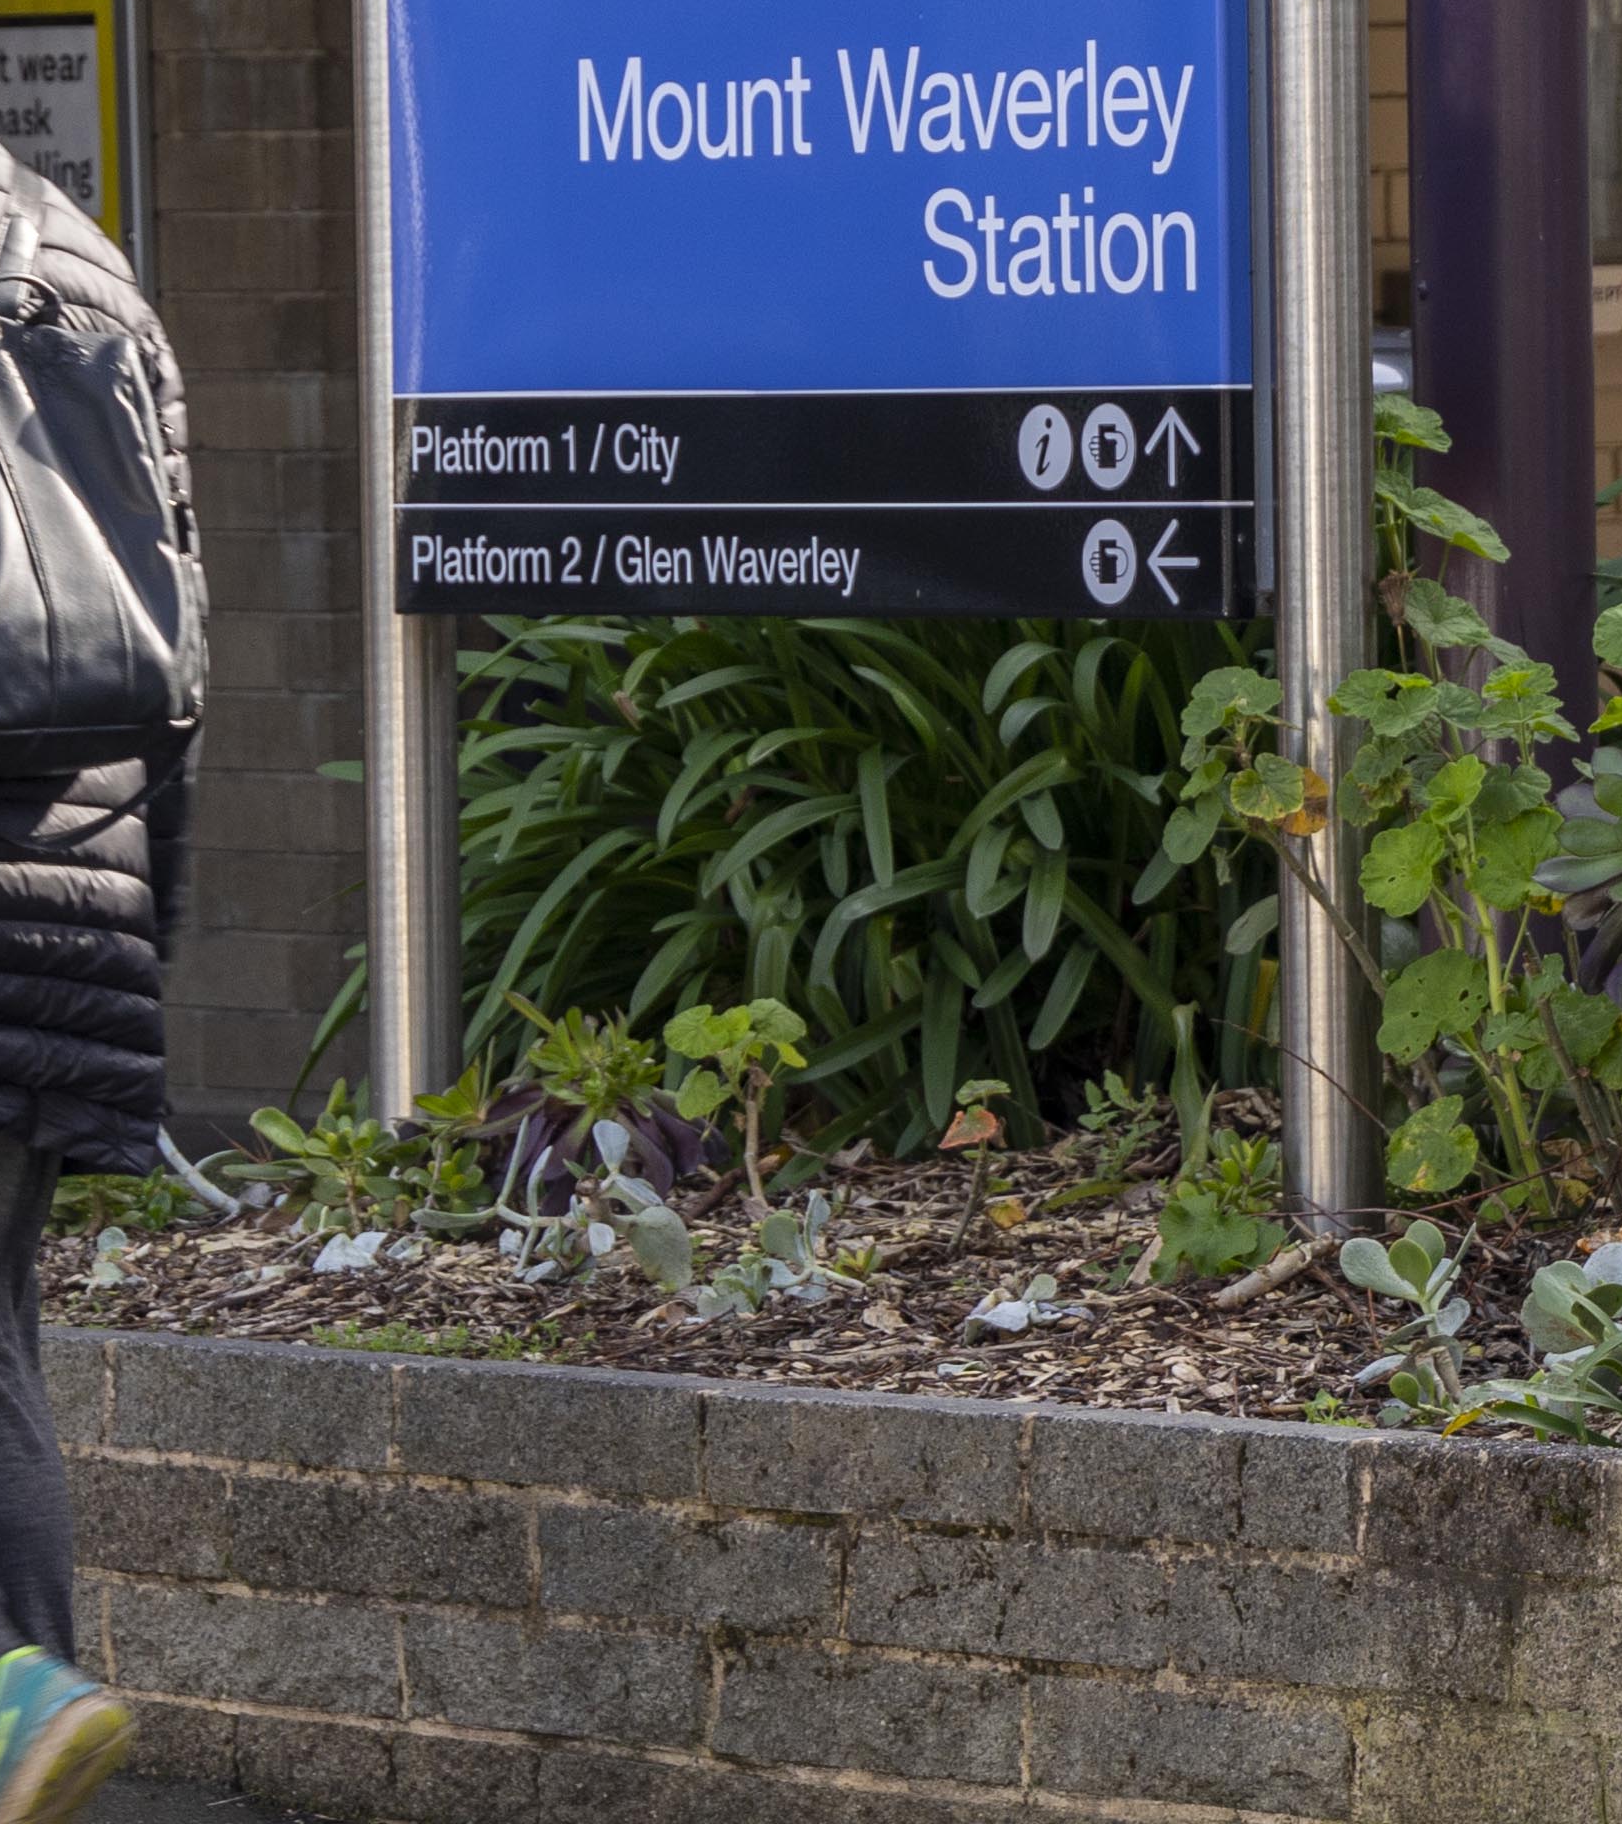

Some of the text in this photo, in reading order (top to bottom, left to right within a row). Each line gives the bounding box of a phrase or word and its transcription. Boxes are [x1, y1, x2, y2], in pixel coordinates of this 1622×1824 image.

[17, 52, 89, 83] wear
[577, 38, 1195, 175] Mount Waverley
[922, 185, 1197, 299] Station
[410, 423, 550, 474] Platform
[561, 424, 577, 473] 1
[613, 422, 680, 485] City
[411, 533, 552, 584] Platform
[560, 535, 583, 583] 2
[614, 534, 693, 584] Glen
[702, 534, 861, 597] Waverley
